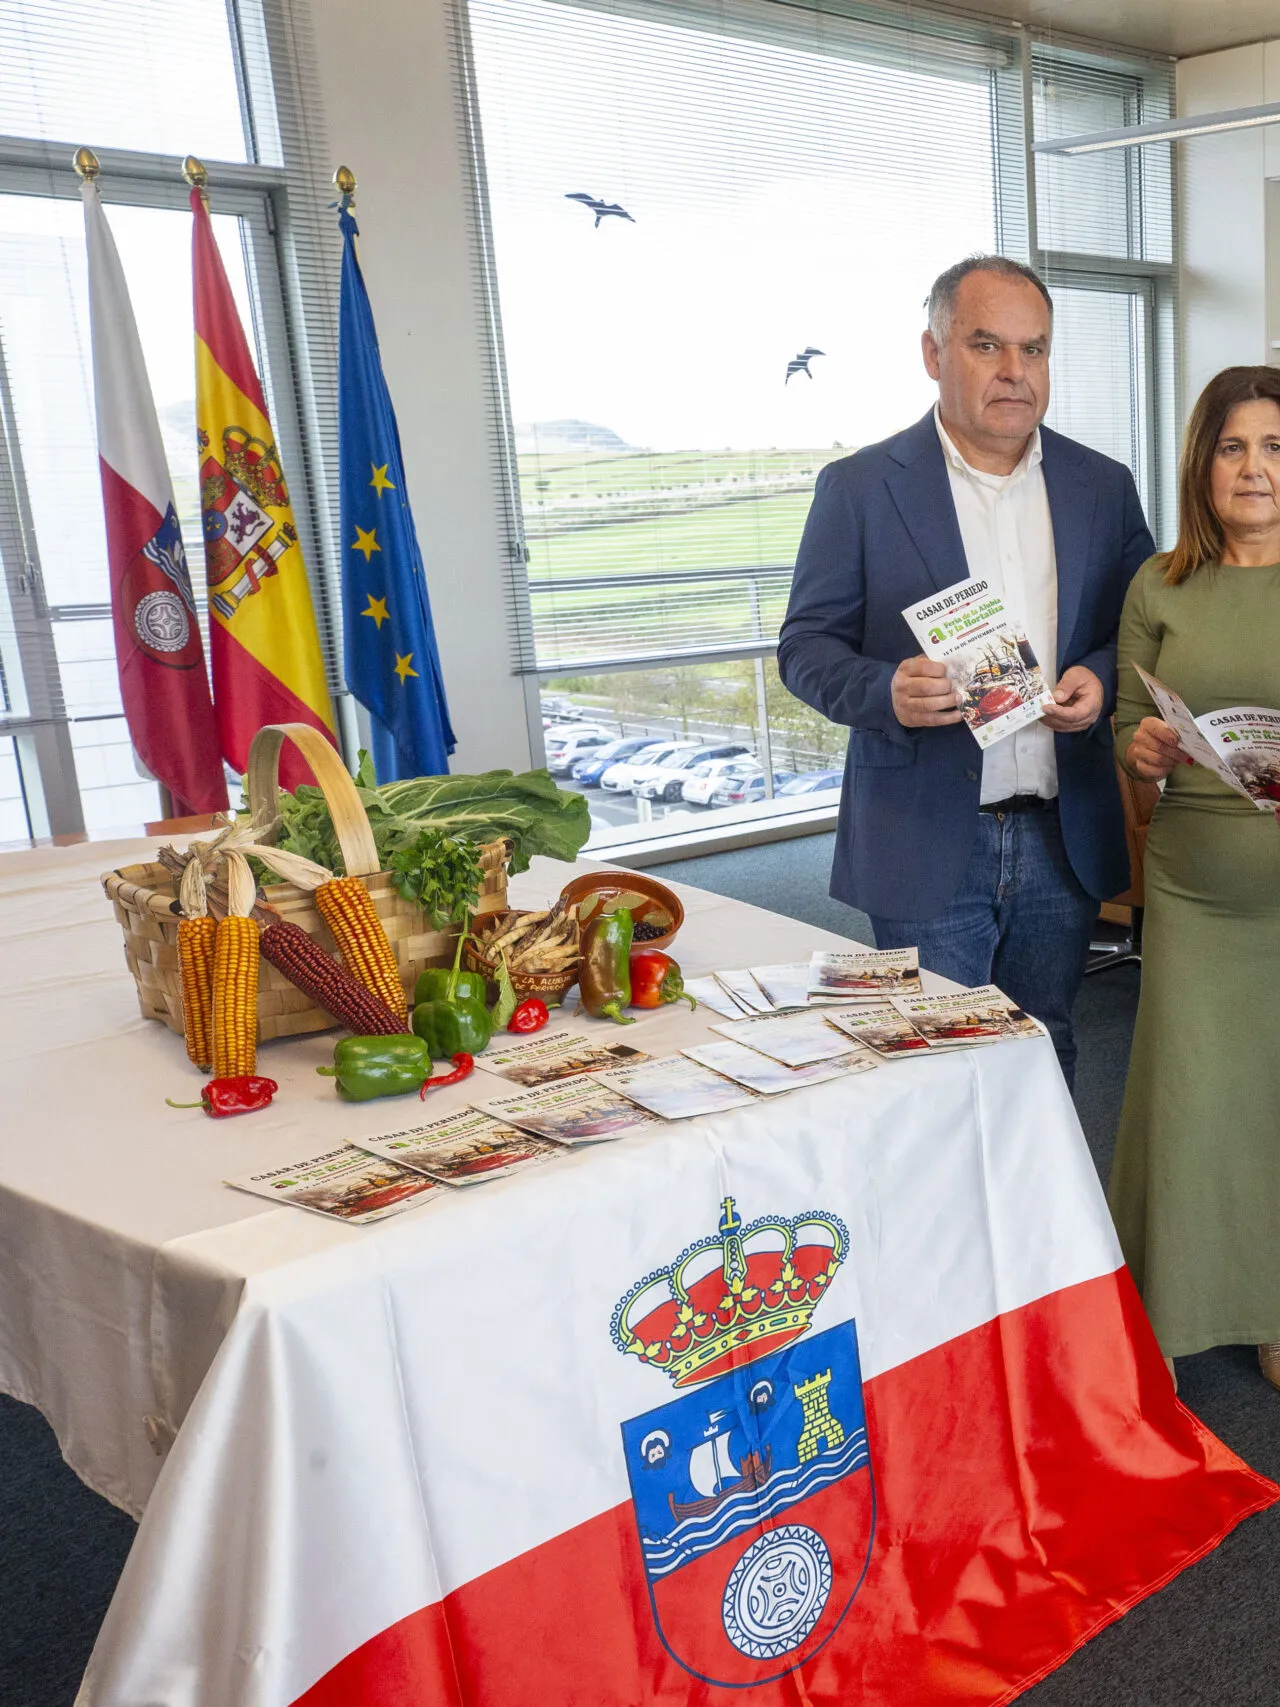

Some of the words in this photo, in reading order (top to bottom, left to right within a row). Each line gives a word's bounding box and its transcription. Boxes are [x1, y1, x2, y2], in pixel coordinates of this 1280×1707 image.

[916, 603, 945, 621] CASAR
[943, 595, 956, 608] DE
[955, 580, 989, 601] PERIEDO
[1210, 714, 1242, 727] CASAR
[1243, 713, 1258, 721] DE
[522, 977, 535, 985] LA
[903, 994, 935, 1003] CASAR
[937, 993, 949, 1001] DE
[488, 1096, 526, 1106] CASAR
[527, 1089, 543, 1098] DE
[542, 1077, 589, 1094] PERIEDO
[368, 1130, 409, 1143] CASAR
[409, 1125, 426, 1134] DE
[427, 1109, 475, 1130] PERIEDO
[250, 1162, 295, 1182] CASAR
[294, 1158, 313, 1169] DE
[311, 1144, 356, 1163] PERIED
